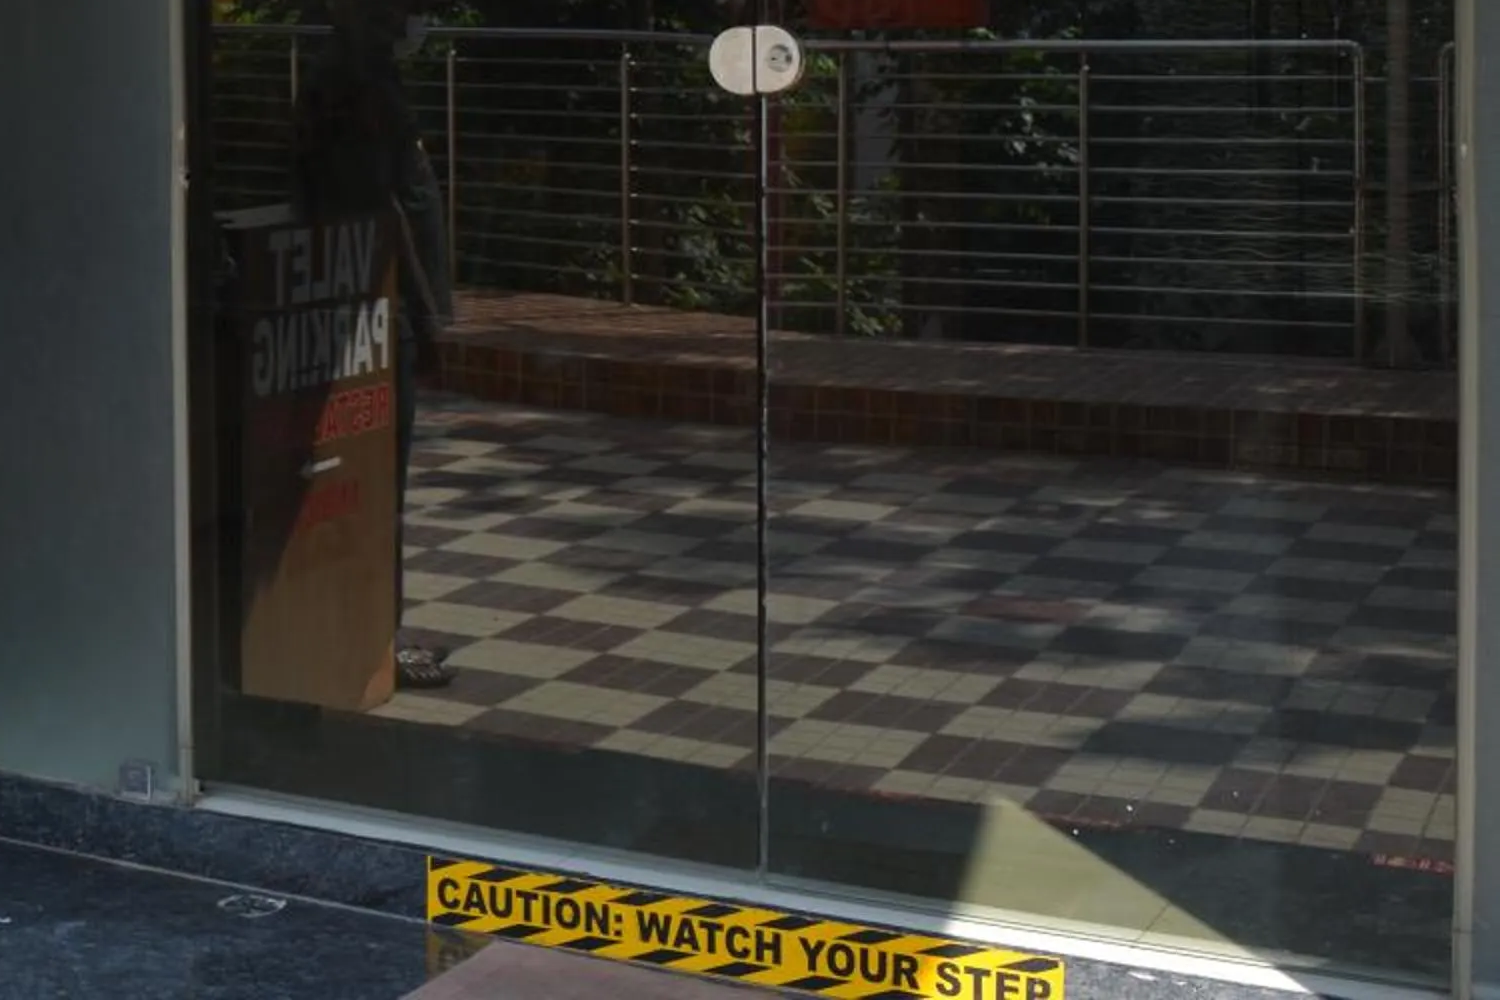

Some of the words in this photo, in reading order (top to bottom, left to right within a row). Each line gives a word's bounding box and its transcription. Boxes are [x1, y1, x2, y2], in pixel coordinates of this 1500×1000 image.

[437, 878, 623, 938] CAUTION:
[637, 912, 782, 965] WATCH
[798, 936, 920, 990] YOUR
[935, 961, 1052, 1000] STEP
